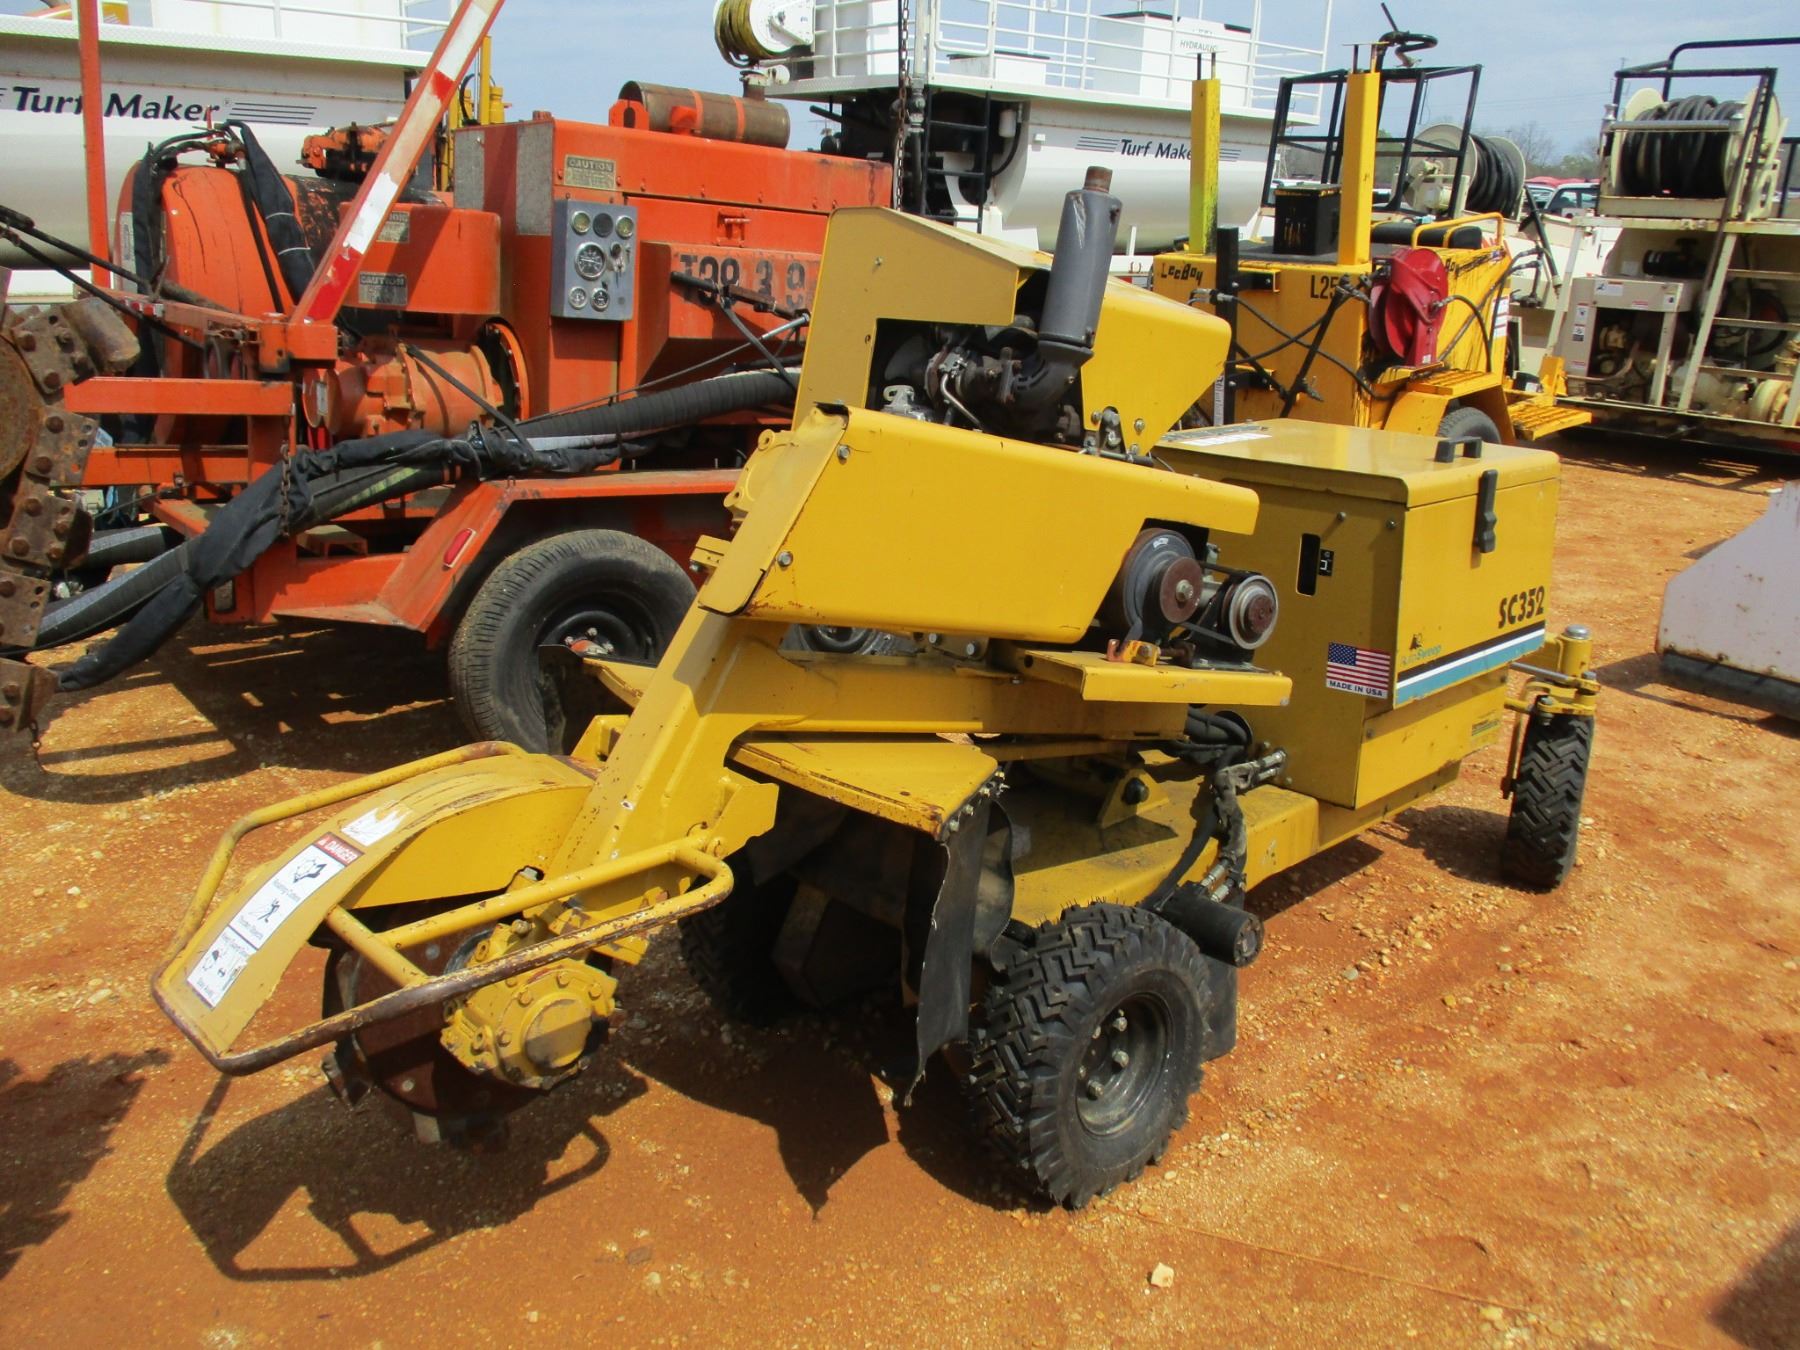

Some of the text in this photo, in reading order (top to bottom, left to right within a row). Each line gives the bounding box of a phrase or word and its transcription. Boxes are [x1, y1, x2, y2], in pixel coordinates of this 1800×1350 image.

[104, 93, 220, 121] Maker
[1121, 139, 1192, 160] Turf Make
[569, 158, 613, 172] CAUTION
[1498, 585, 1545, 629] SC352
[1329, 680, 1383, 696] MADE IN USA
[324, 839, 358, 864] DANGER
